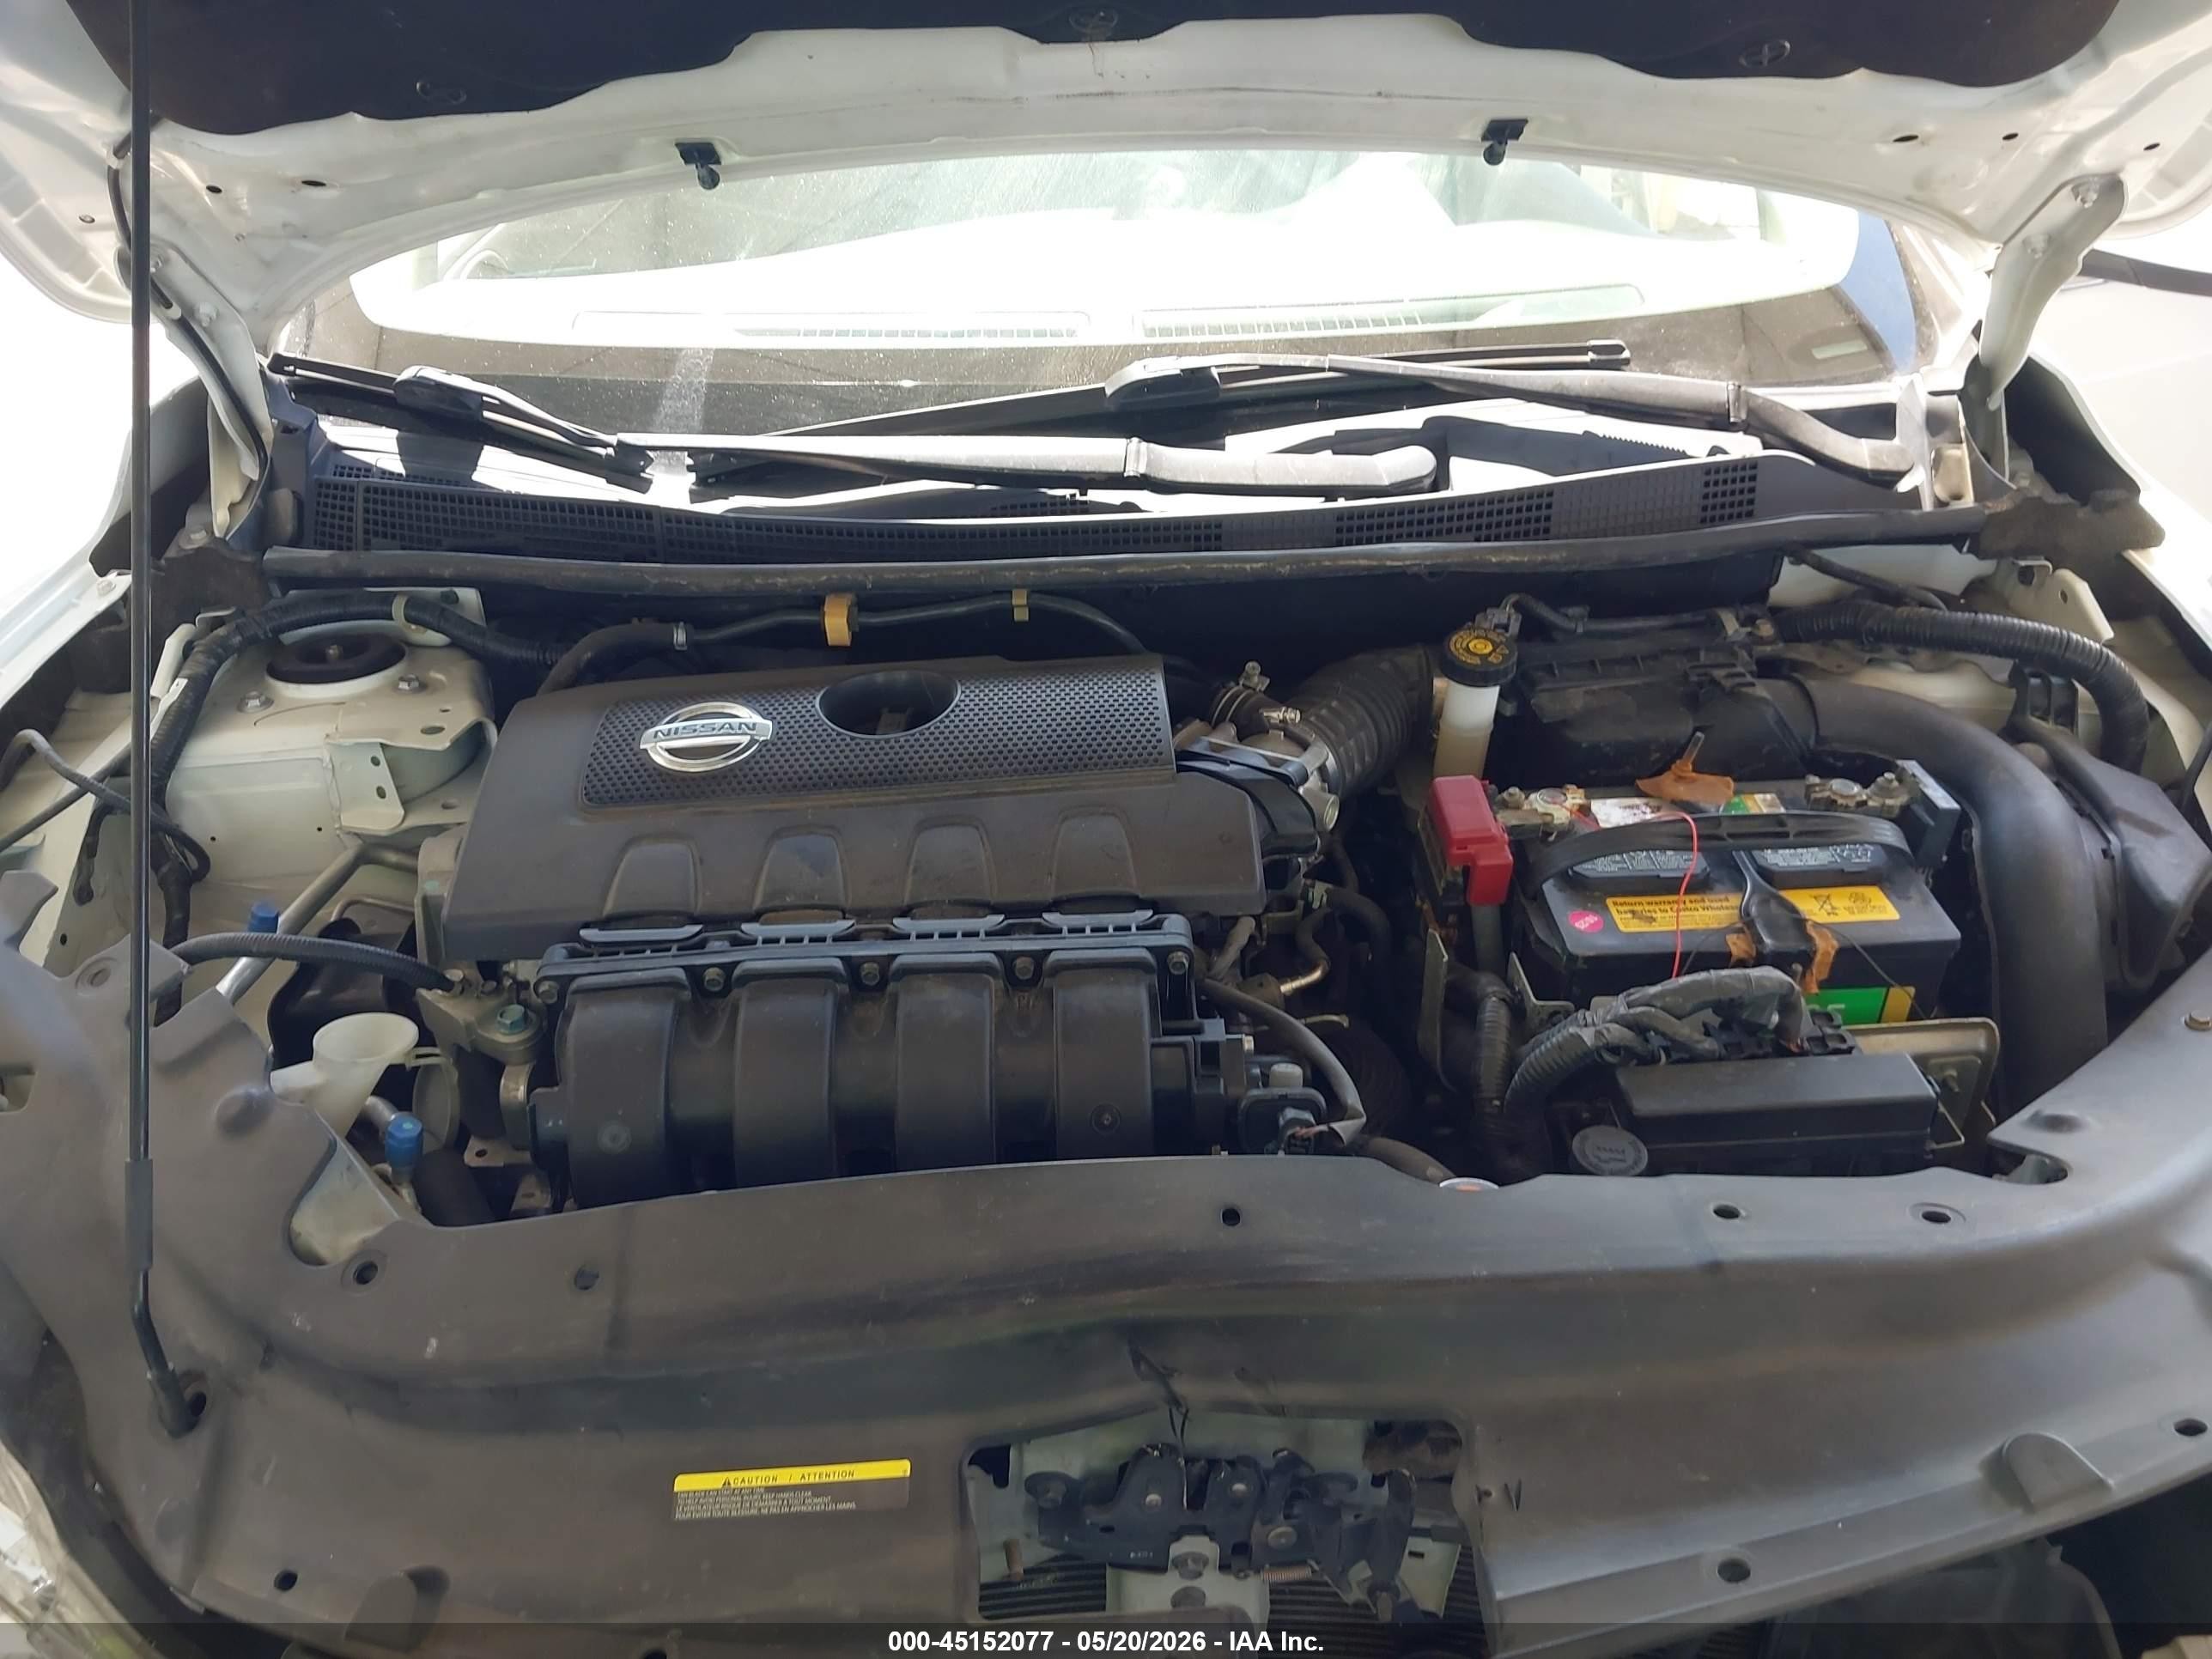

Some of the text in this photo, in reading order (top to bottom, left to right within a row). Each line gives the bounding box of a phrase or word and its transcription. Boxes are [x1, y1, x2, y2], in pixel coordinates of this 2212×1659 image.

[653, 721, 757, 738] NISSAN
[1645, 898, 1686, 908] warrany
[732, 1475, 778, 1486] CAUTION
[800, 1469, 855, 1481] ATTENTION
